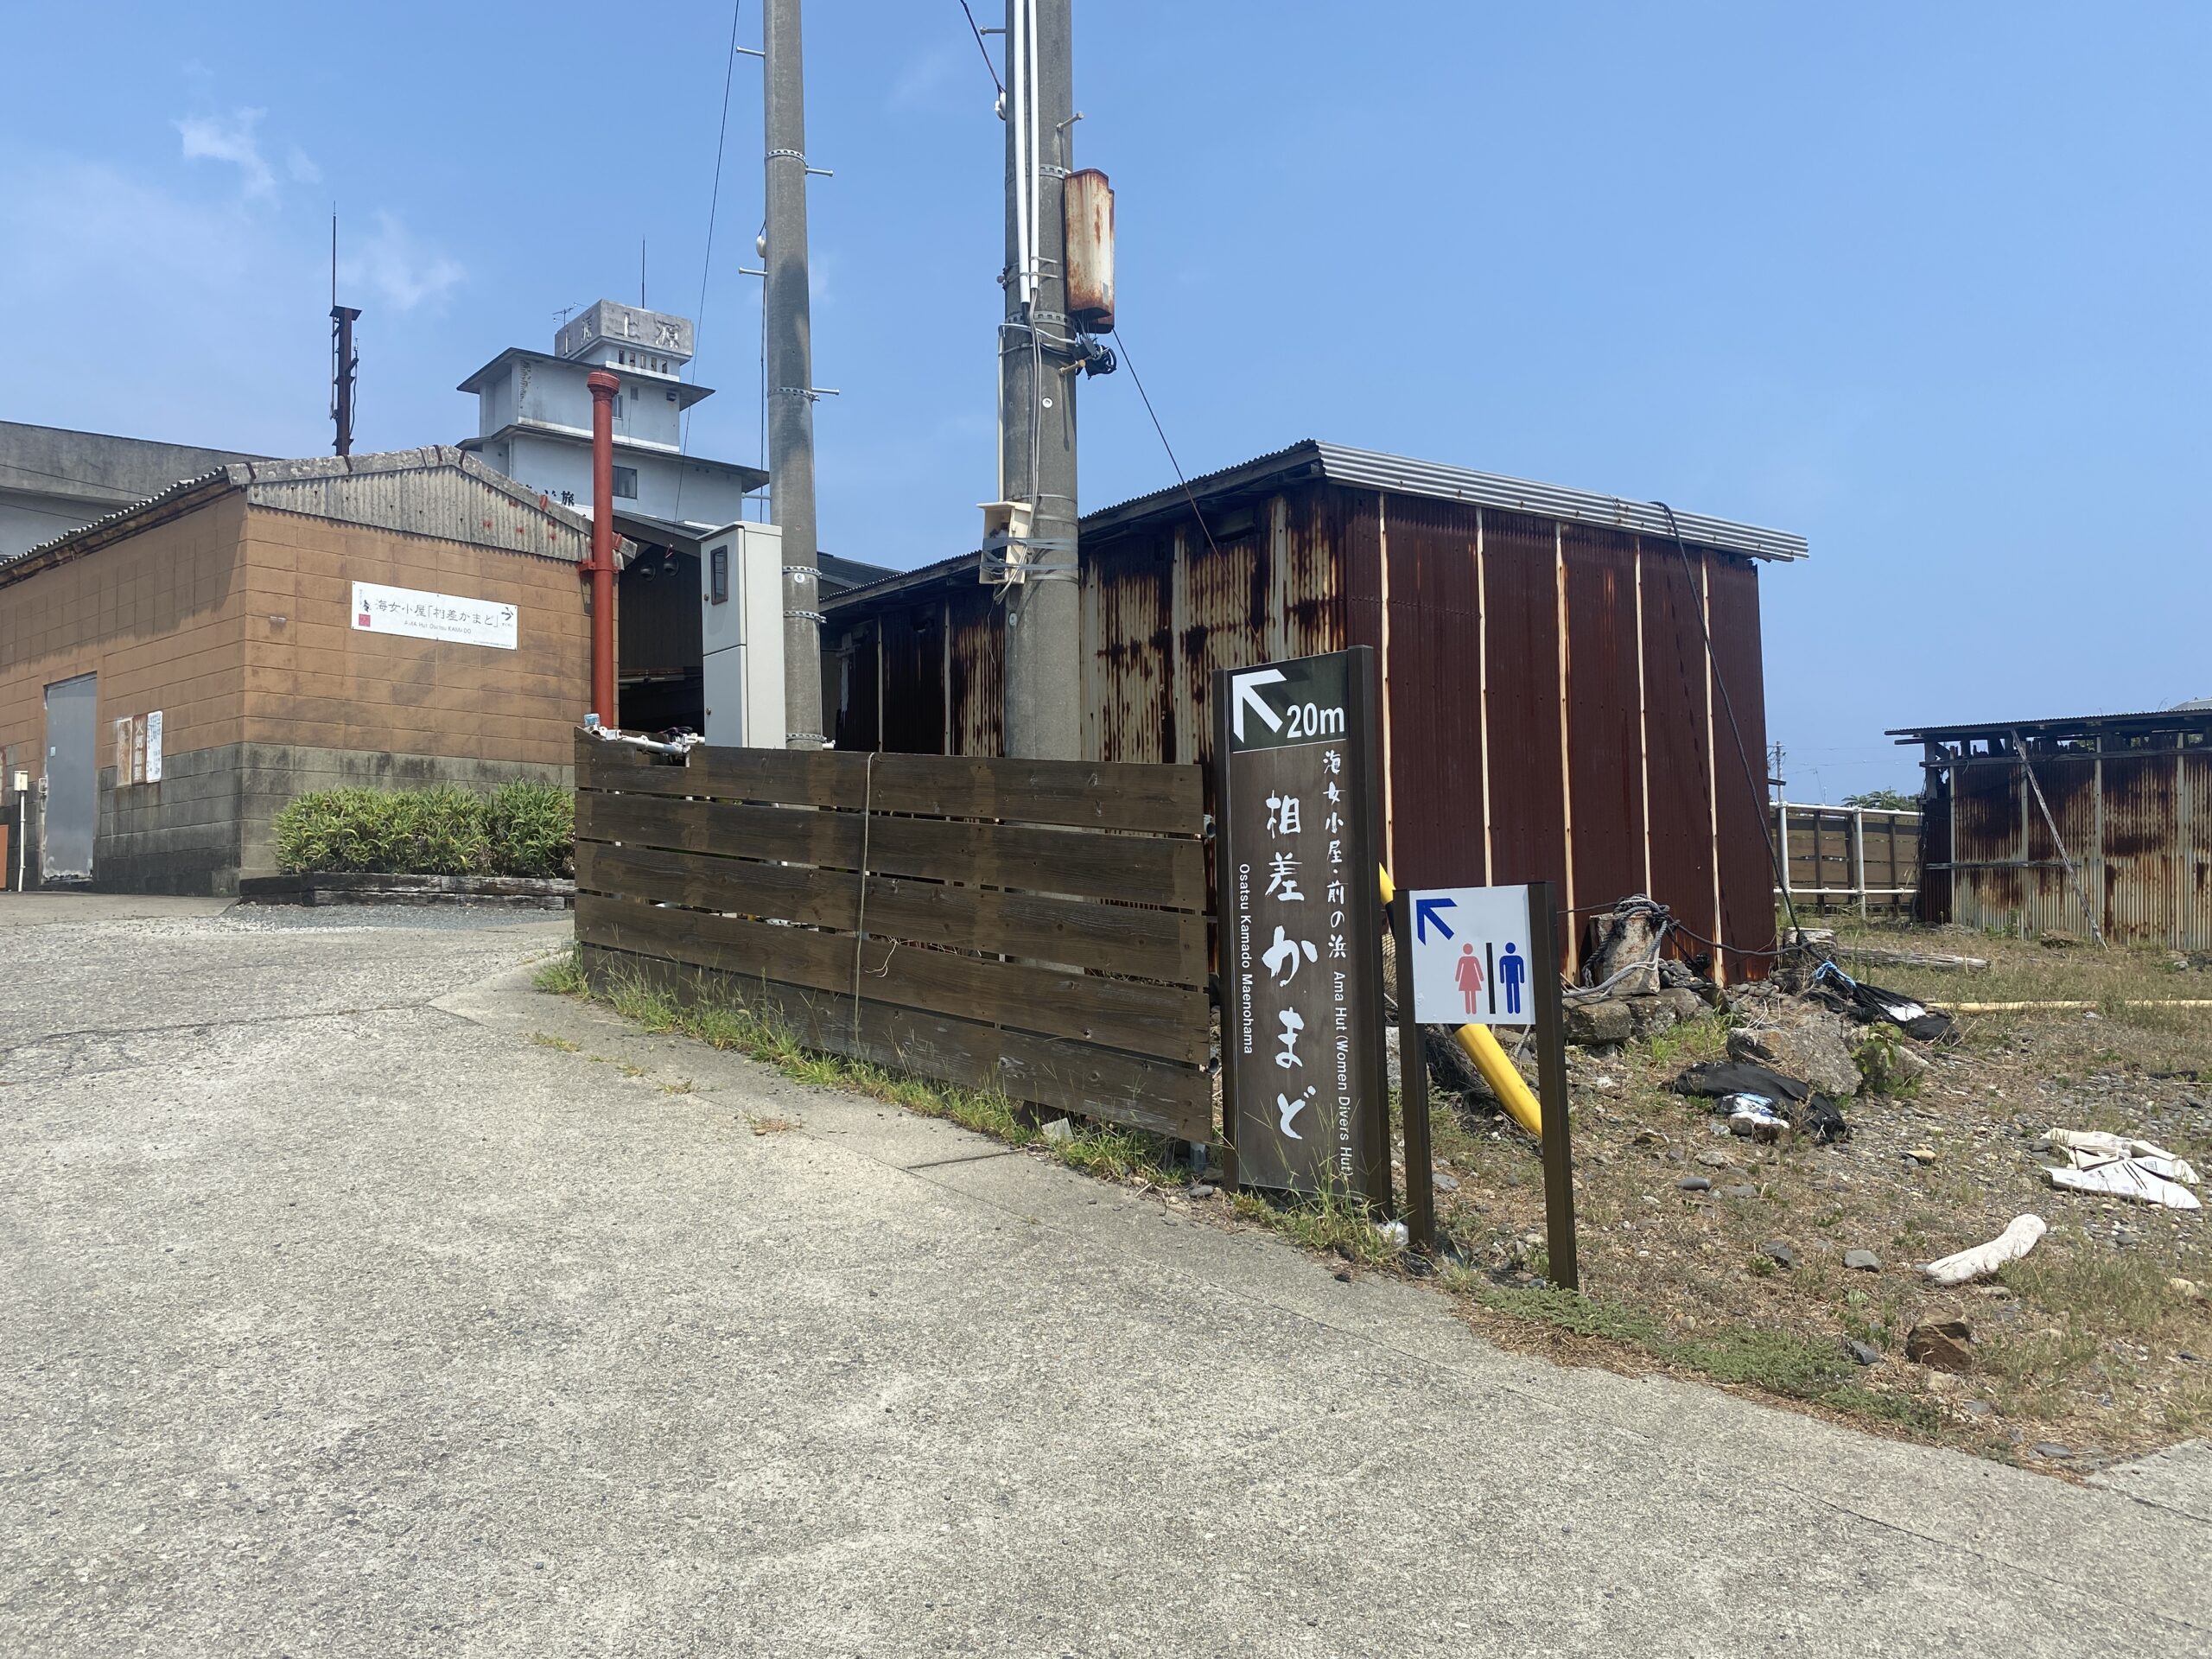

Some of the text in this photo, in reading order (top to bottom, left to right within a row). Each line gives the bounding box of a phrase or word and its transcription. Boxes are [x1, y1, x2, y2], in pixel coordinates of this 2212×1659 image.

[1287, 702, 1344, 739] 20m
[1239, 863, 1254, 1054] Osatsu Kamado Maenohama
[1261, 790, 1319, 1140] 相差かまど
[1333, 970, 1354, 1176] Ama Hut (Women Divers Hut)
